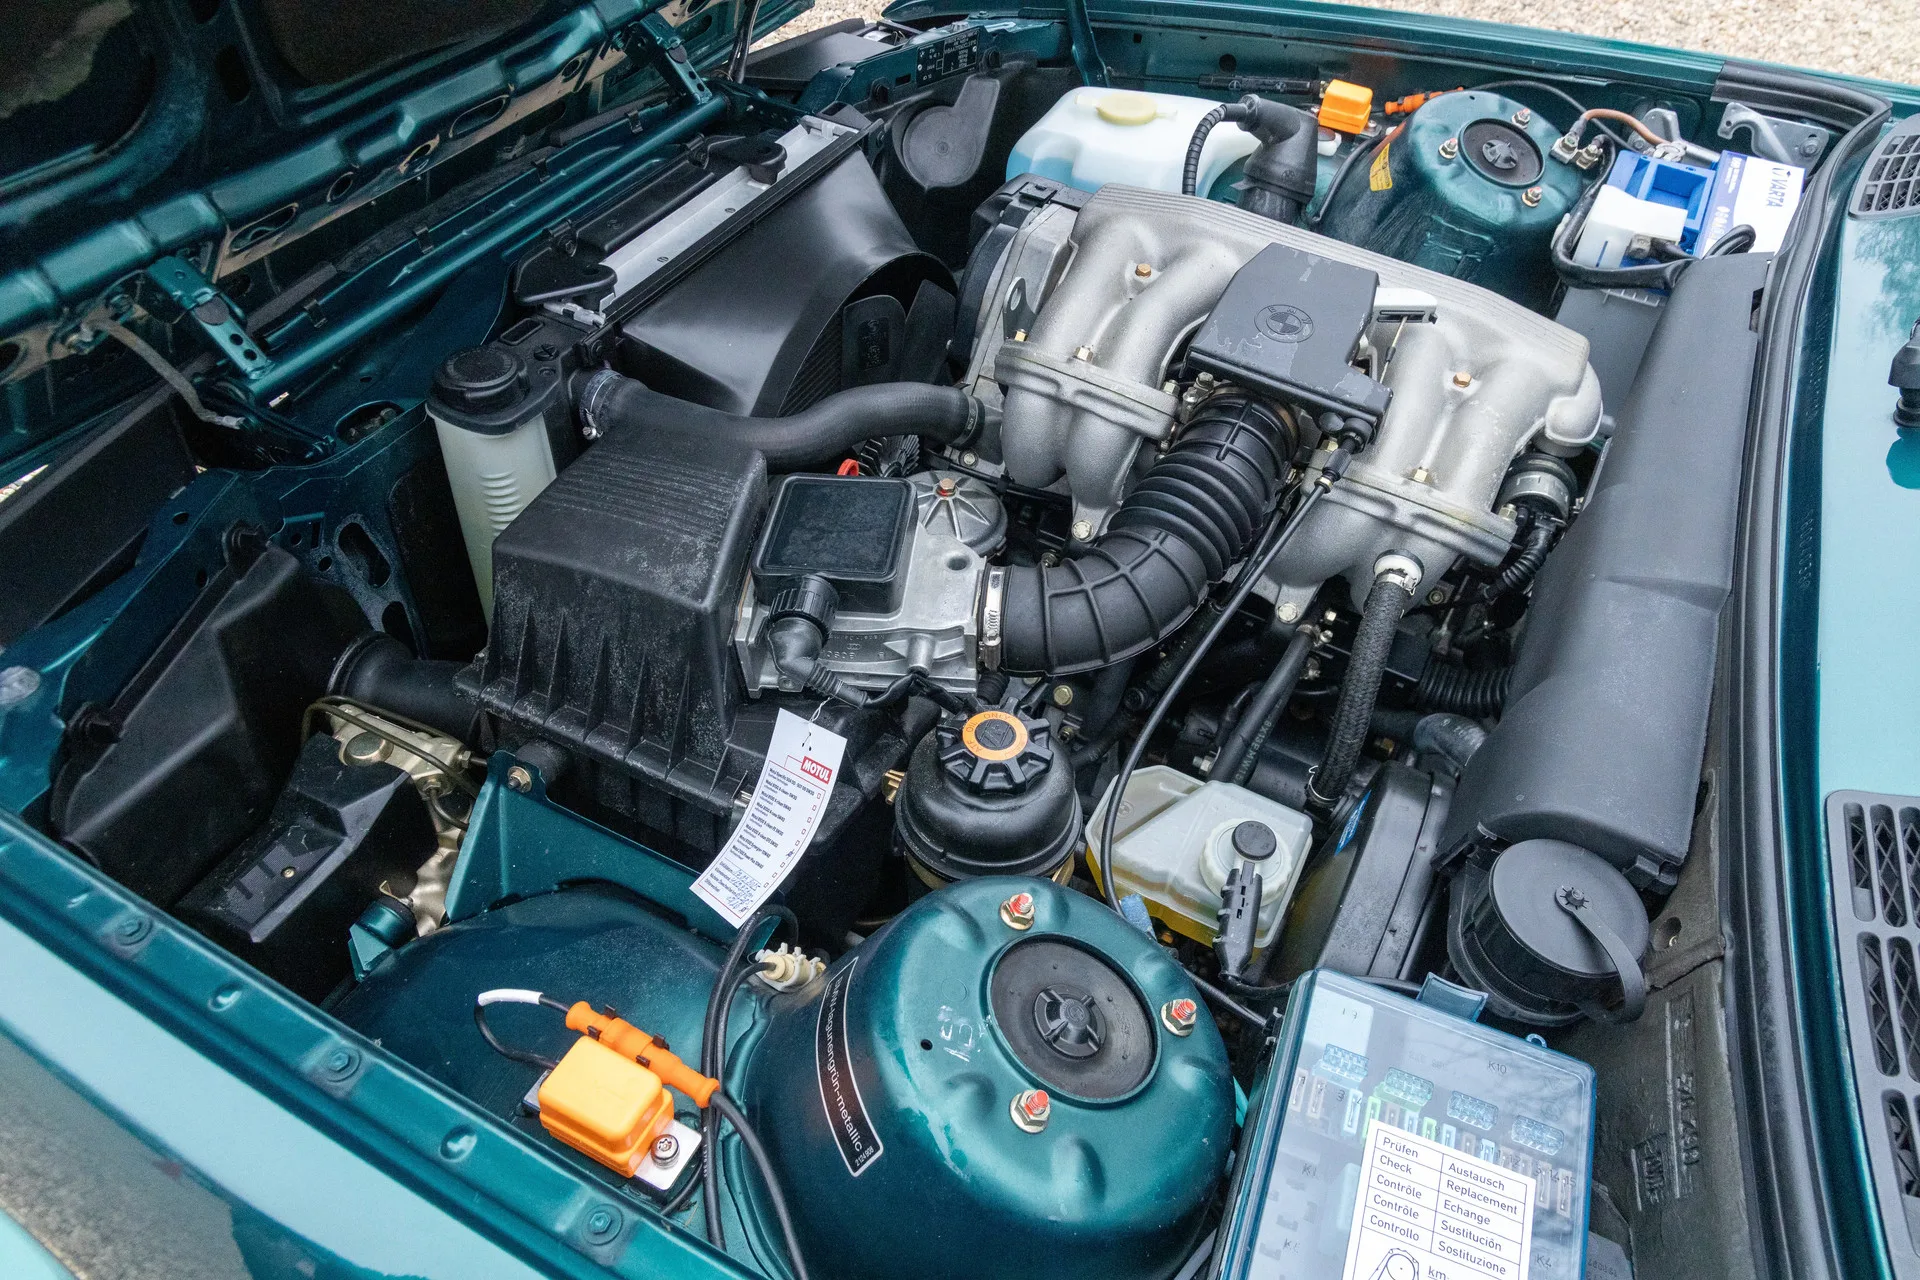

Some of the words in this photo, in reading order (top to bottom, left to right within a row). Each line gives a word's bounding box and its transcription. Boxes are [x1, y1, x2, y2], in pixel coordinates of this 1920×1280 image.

[1765, 177, 1788, 208] VARTA
[966, 721, 978, 733] OIL
[802, 758, 831, 782] MOTUL
[1487, 1060, 1508, 1076] K10
[1382, 1136, 1419, 1158] Prüfen
[1448, 1162, 1505, 1191] Austausch
[1376, 1174, 1422, 1199] Contrôle
[1443, 1199, 1491, 1226] Echange
[1379, 1154, 1412, 1175] Check
[1446, 1179, 1518, 1215] Replacement
[1373, 1194, 1419, 1219] Contrôle
[1370, 1214, 1420, 1241] Controllo
[1438, 1240, 1506, 1275] Sostituzione
